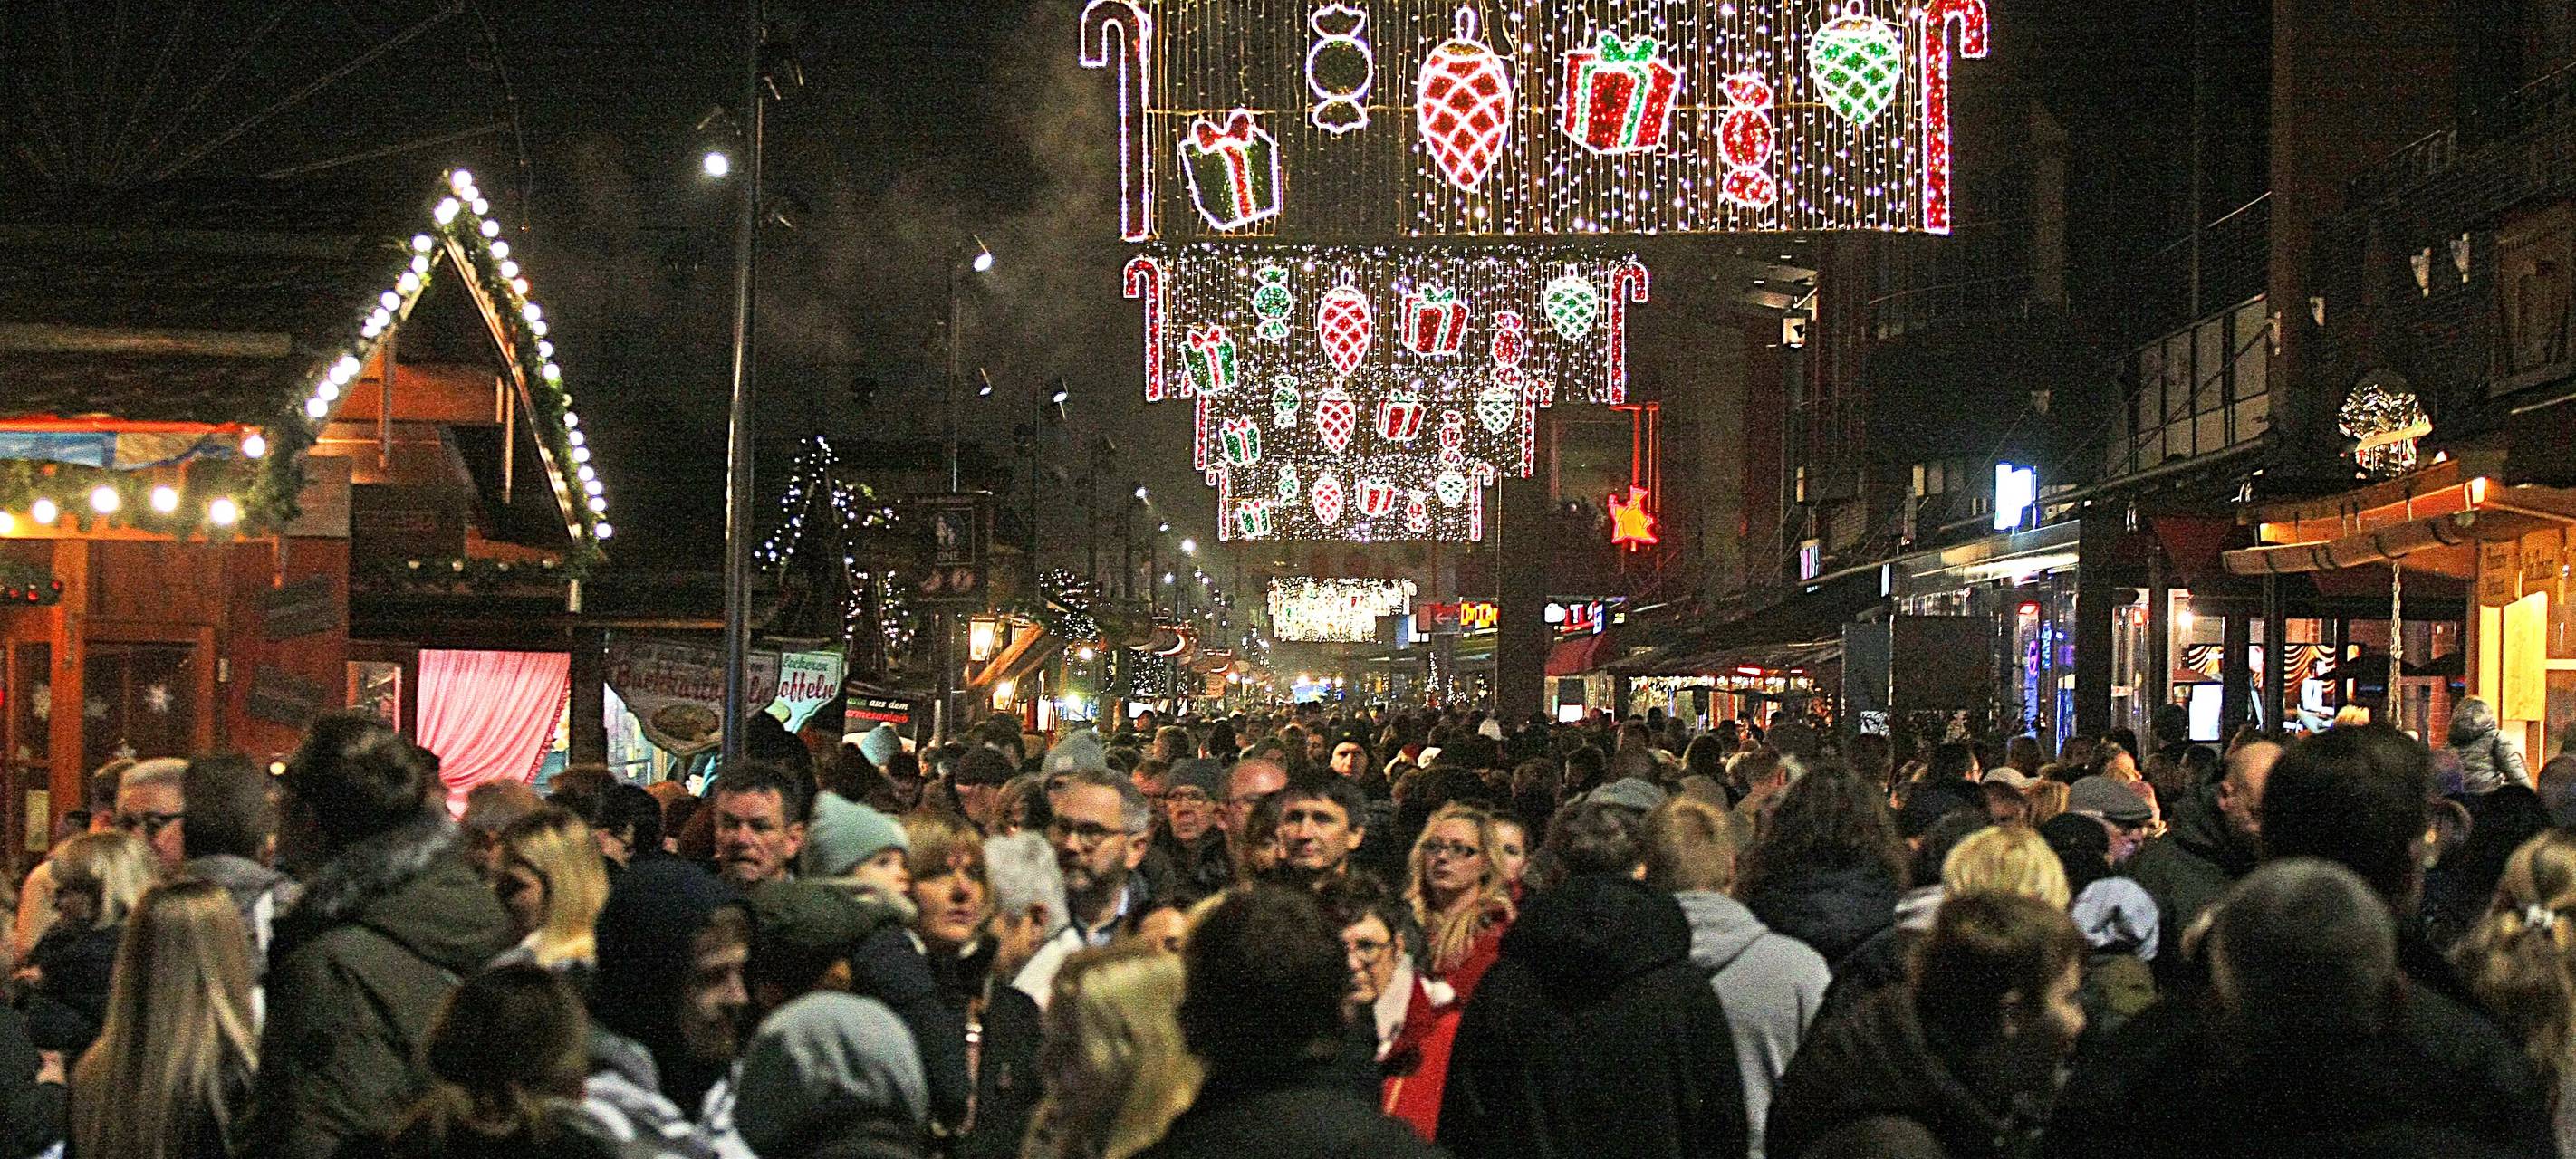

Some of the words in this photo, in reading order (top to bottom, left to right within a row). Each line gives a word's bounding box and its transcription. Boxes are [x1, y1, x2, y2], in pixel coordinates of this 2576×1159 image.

[778, 671, 835, 702] offeln
[869, 699, 887, 708] aus
[888, 700, 909, 711] dem
[845, 709, 909, 723] armesanlaib
